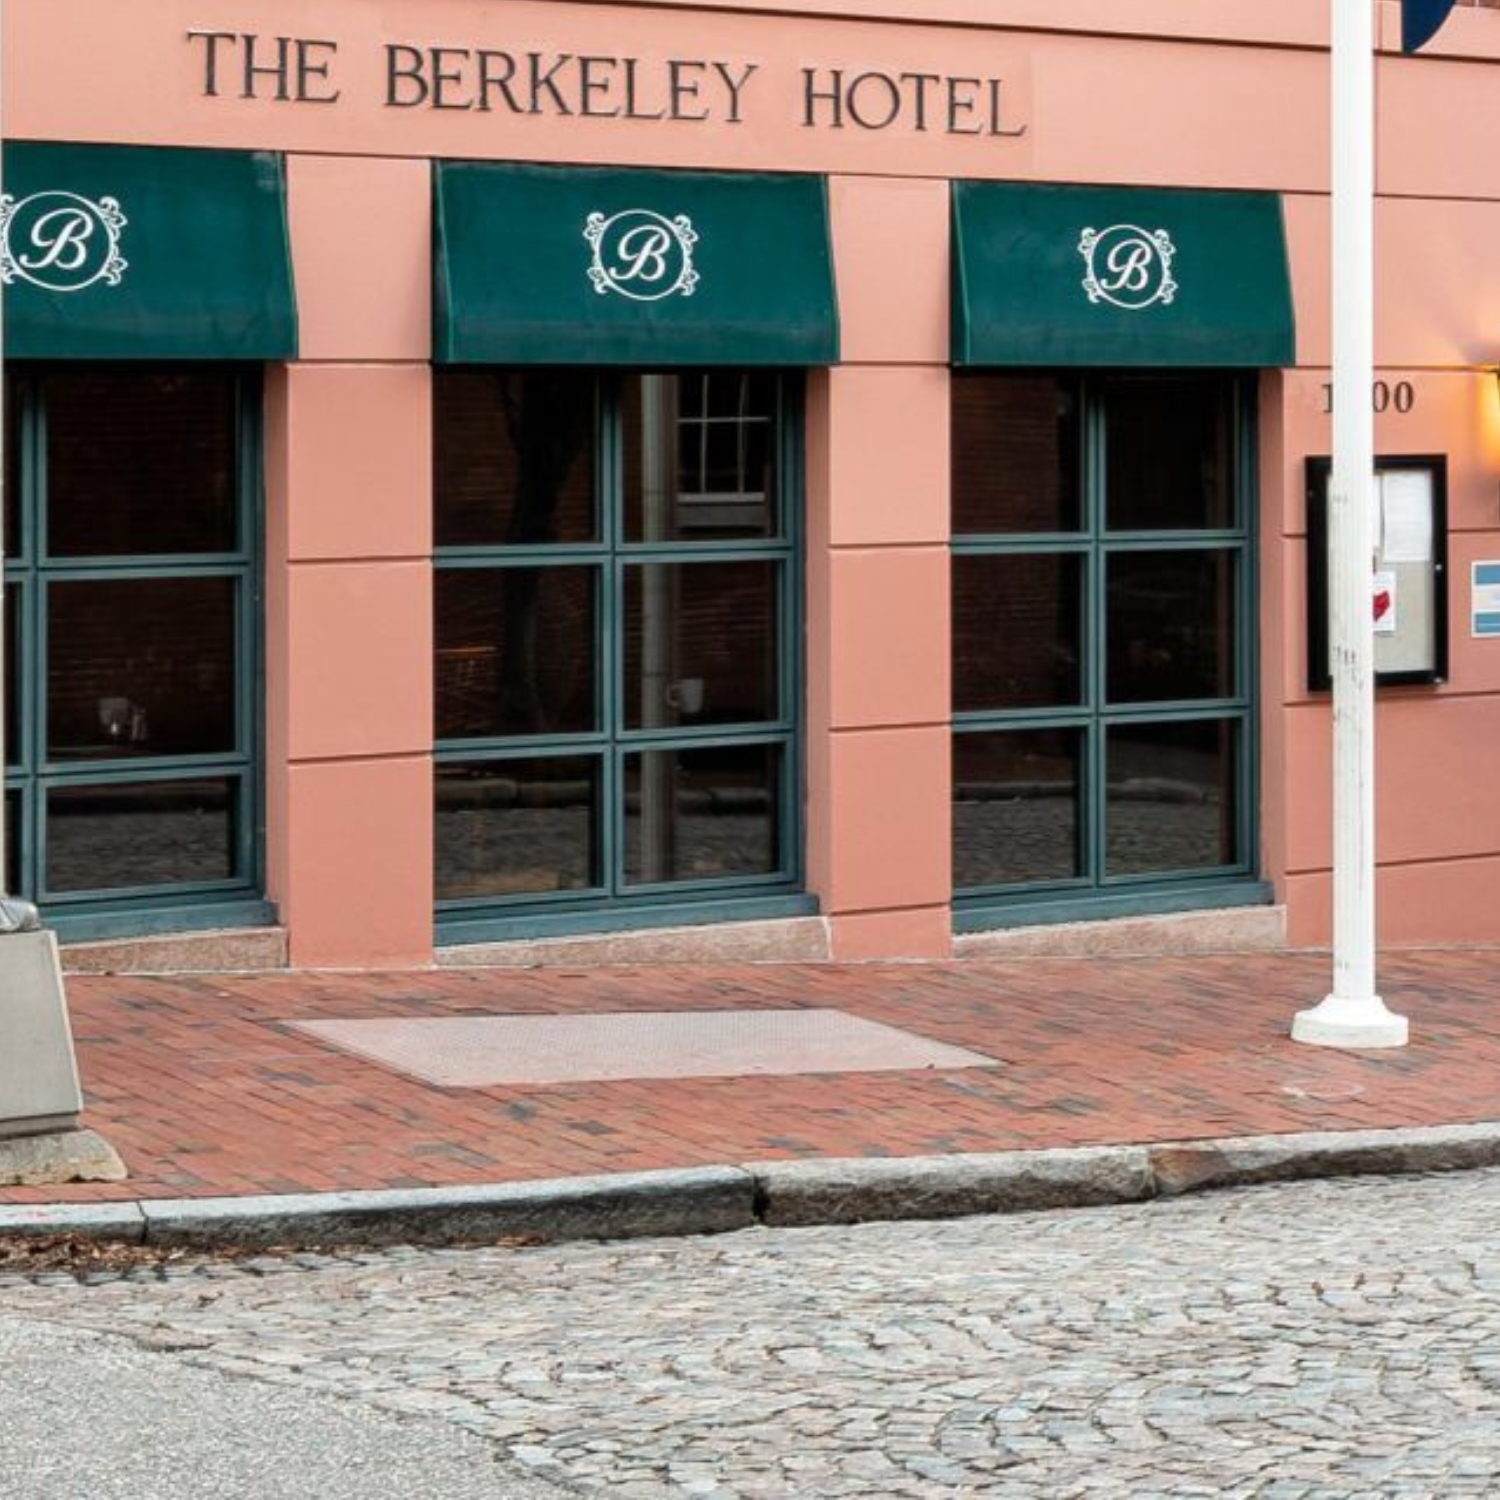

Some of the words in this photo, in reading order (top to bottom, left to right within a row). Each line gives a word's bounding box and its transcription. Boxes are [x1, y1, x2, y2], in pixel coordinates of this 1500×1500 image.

[187, 32, 340, 104] THE
[384, 43, 757, 124] BERKELEY
[802, 69, 1028, 137] HOTEL
[1321, 382, 1414, 413] 100
